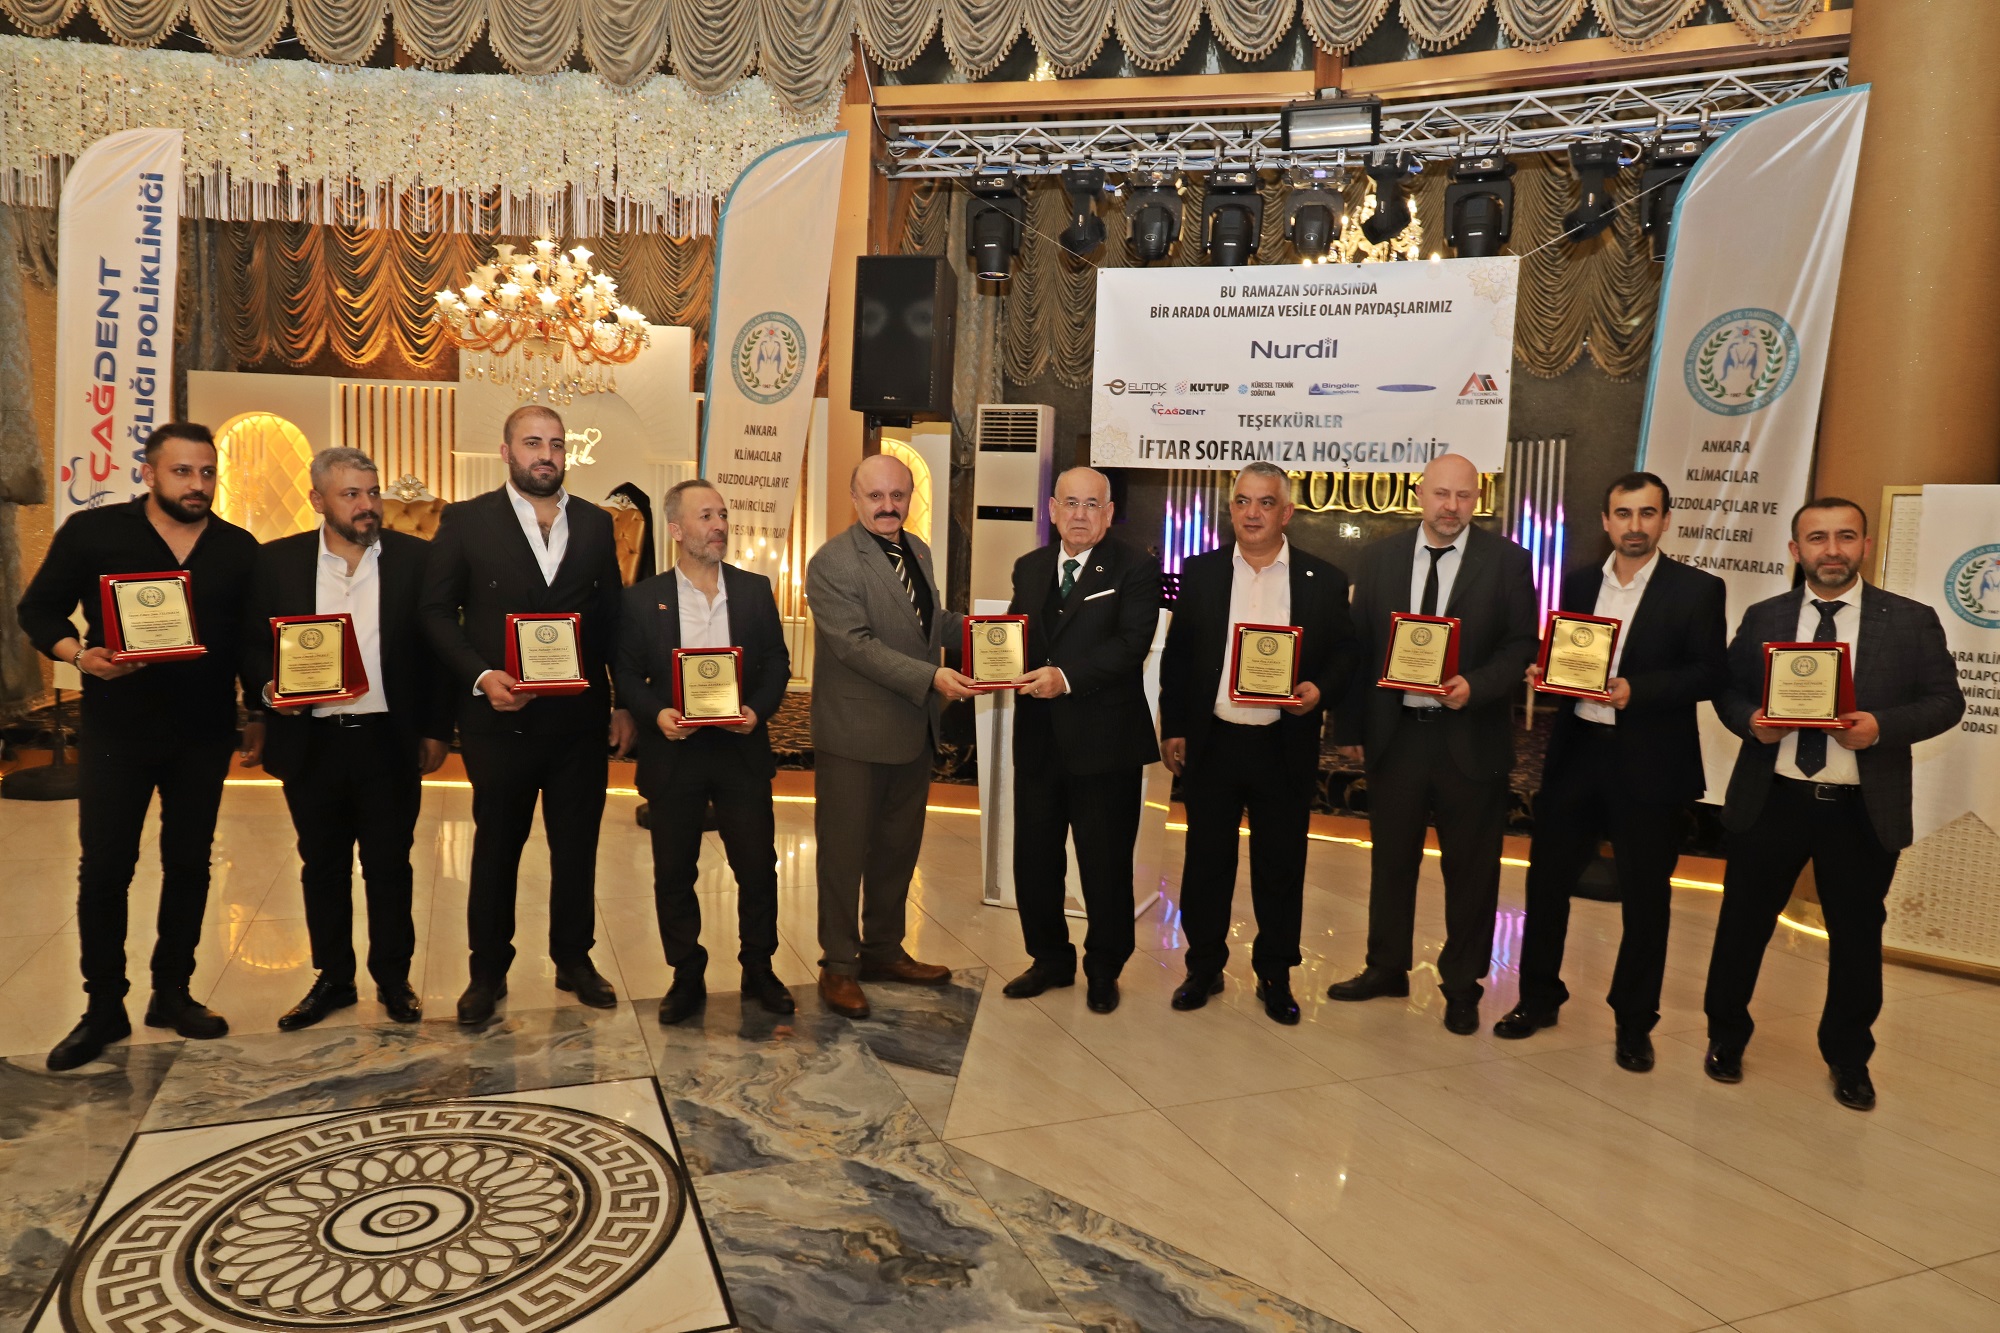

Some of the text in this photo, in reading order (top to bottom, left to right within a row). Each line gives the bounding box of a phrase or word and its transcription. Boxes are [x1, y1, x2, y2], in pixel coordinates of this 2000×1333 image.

[132, 172, 165, 358] POLİKLİNİĞİ
[1220, 282, 1378, 298] BU RAMAZAN SOFRASINDA
[1150, 300, 1453, 319] BİR ARADA OLMAMIZA VESİLE OLAN PAYDAŞLARIMIZ
[1250, 337, 1338, 360] Nurdil
[86, 255, 123, 482] ÇAĞDENT
[1189, 382, 1230, 393] KUTUP
[1250, 380, 1294, 389] KÜRESEL TEKNİK
[1321, 382, 1360, 390] Bingöler
[1250, 389, 1276, 397] SOĞUTMA
[1456, 396, 1504, 406] ATM TEKNİK
[1157, 407, 1206, 416] ÇAĞDENT
[1238, 411, 1343, 431] TEŞEKKÜRLER
[744, 424, 778, 437] ANKARA
[734, 447, 782, 463] KLİMACILAR
[1138, 434, 1191, 460] İFTAR
[1195, 440, 1306, 461] SOFRAMIZA
[1701, 440, 1751, 454] ANKARA
[717, 473, 789, 490] BUZDOLAPÇILAR VE
[1686, 466, 1759, 484] KLİMACILAR
[729, 498, 776, 514] TAMİRCİLERİ
[1669, 497, 1779, 516] UZDOLAPÇILAR VE
[1678, 526, 1753, 543] TAMİRCİLERİ
[1693, 555, 1785, 576] SANATKARLAR
[1967, 704, 2000, 717] SANA
[1961, 721, 1998, 735] ODASI
